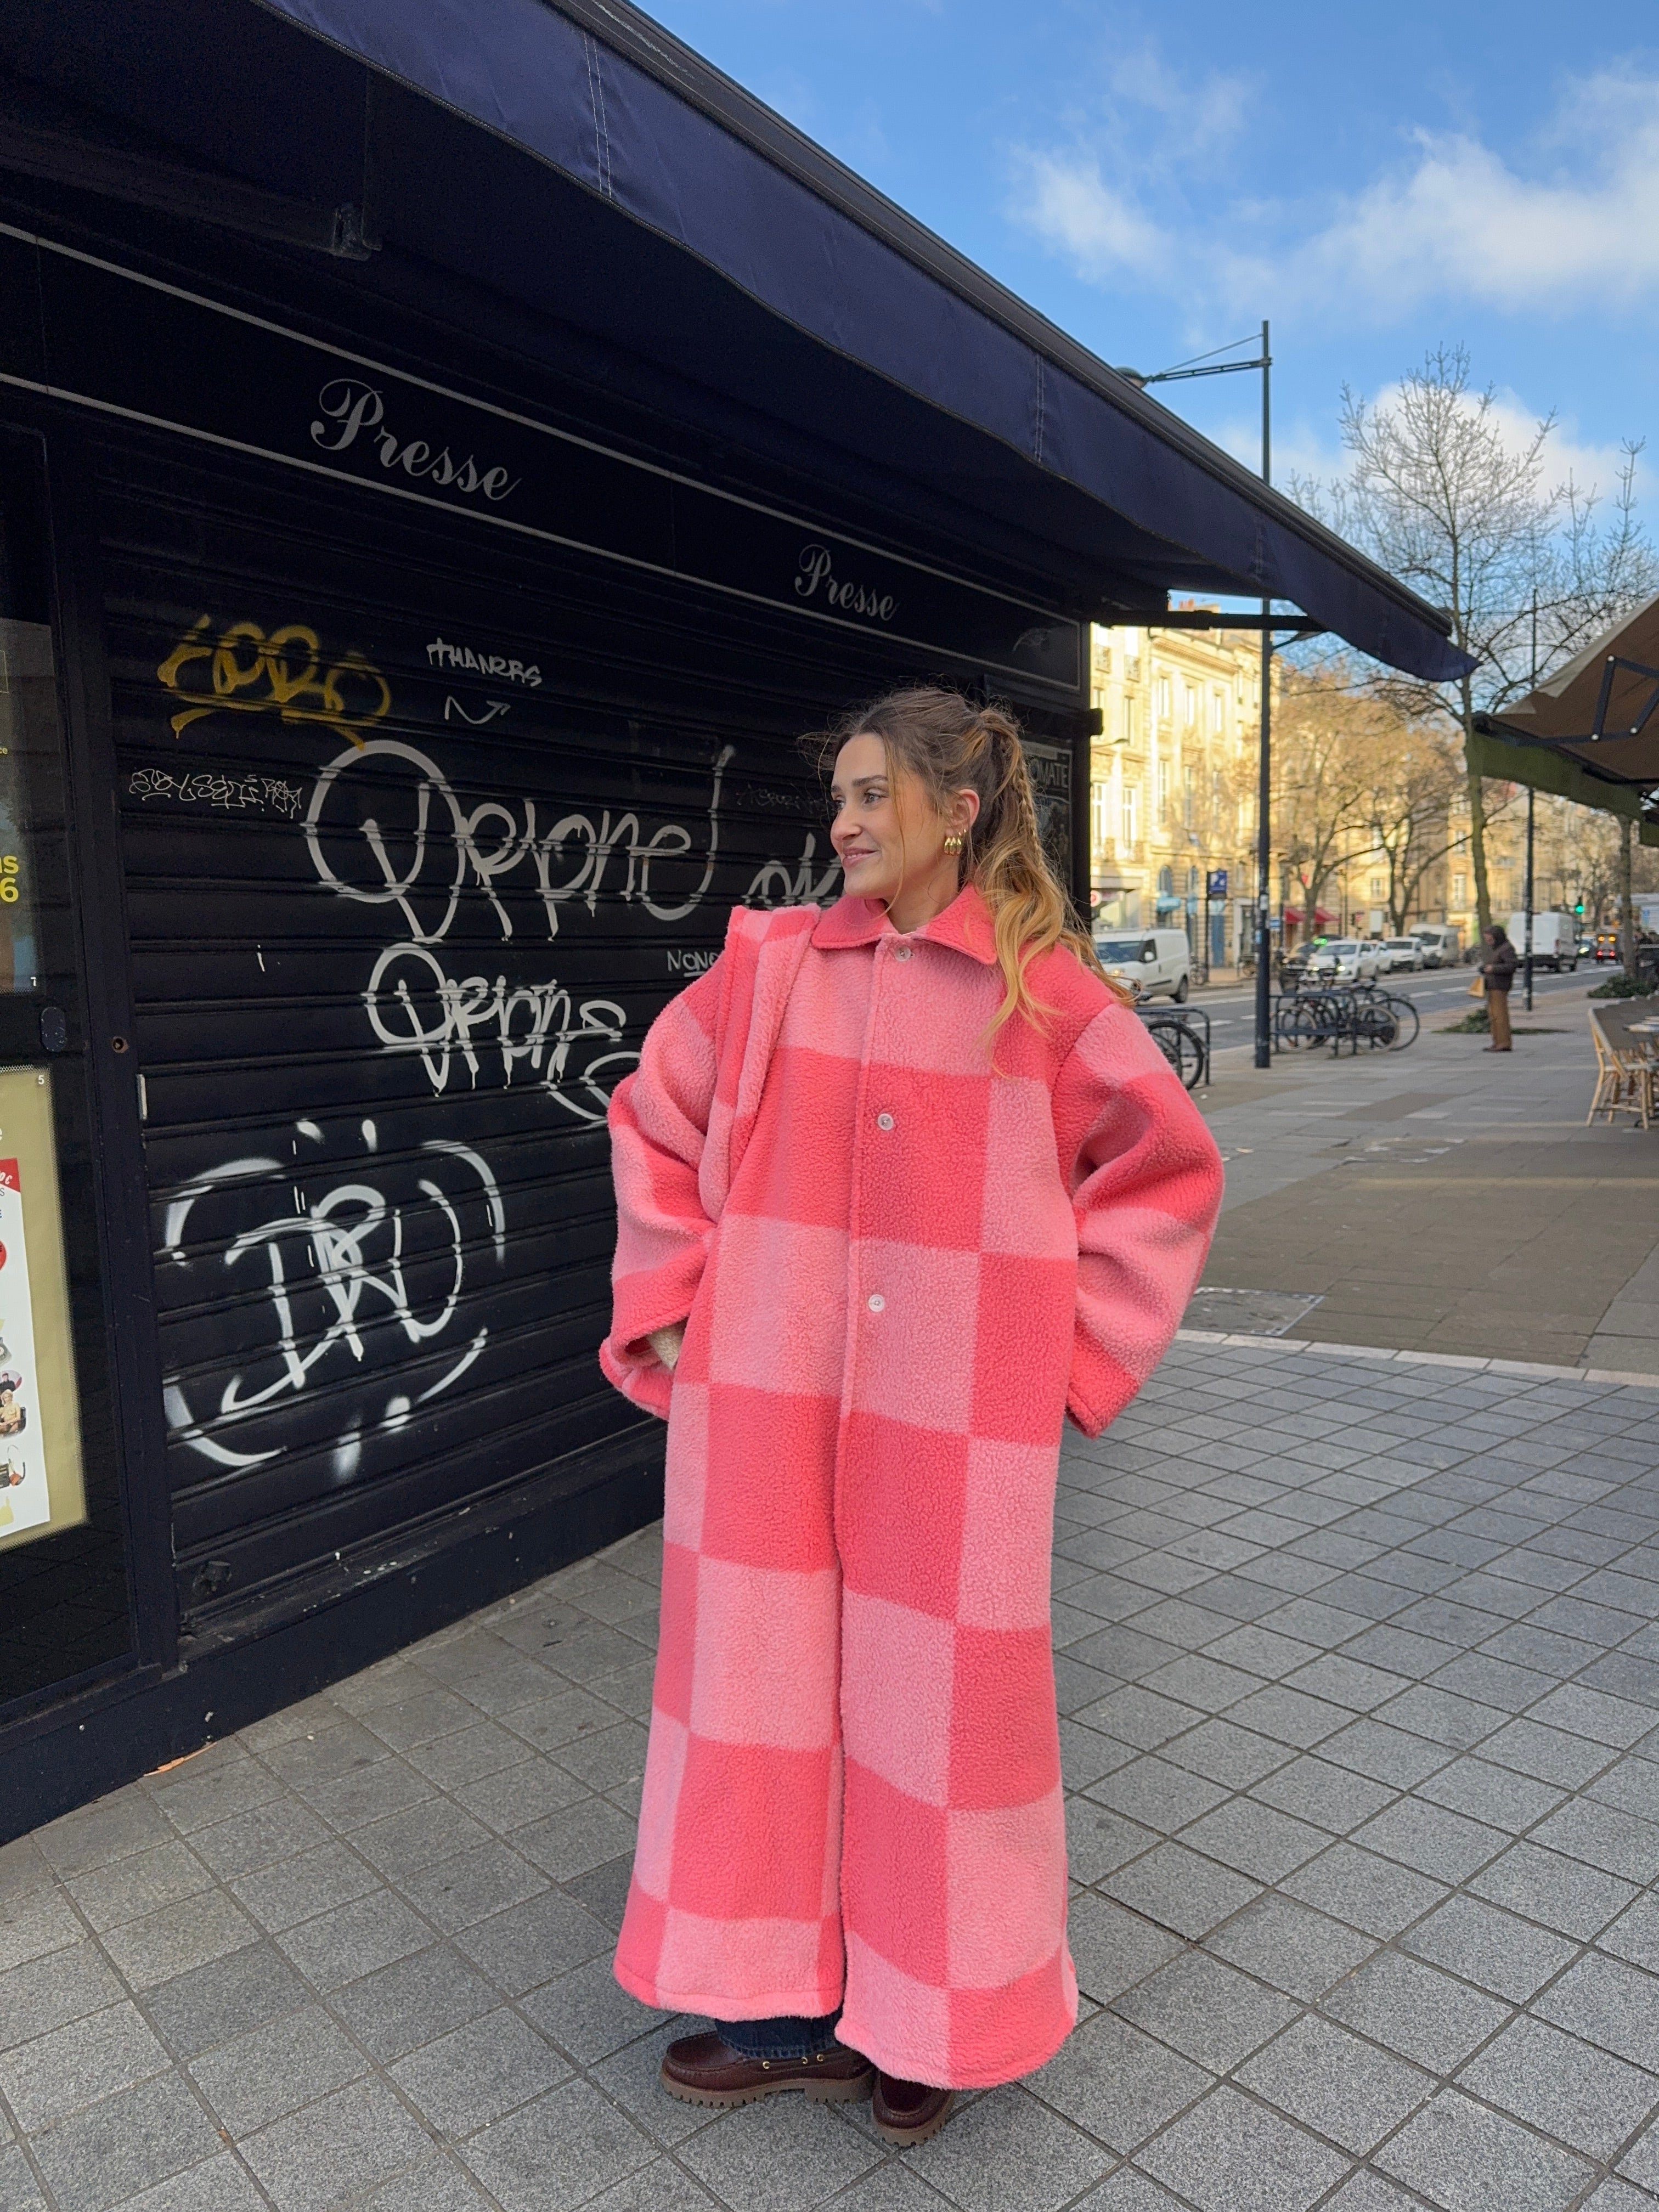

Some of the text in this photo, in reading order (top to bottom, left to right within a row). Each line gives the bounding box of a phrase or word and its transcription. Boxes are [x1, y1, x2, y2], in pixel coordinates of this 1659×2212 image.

[311, 379, 522, 500] Presse
[794, 544, 900, 621] Presse
[38, 1075, 44, 1085] 5
